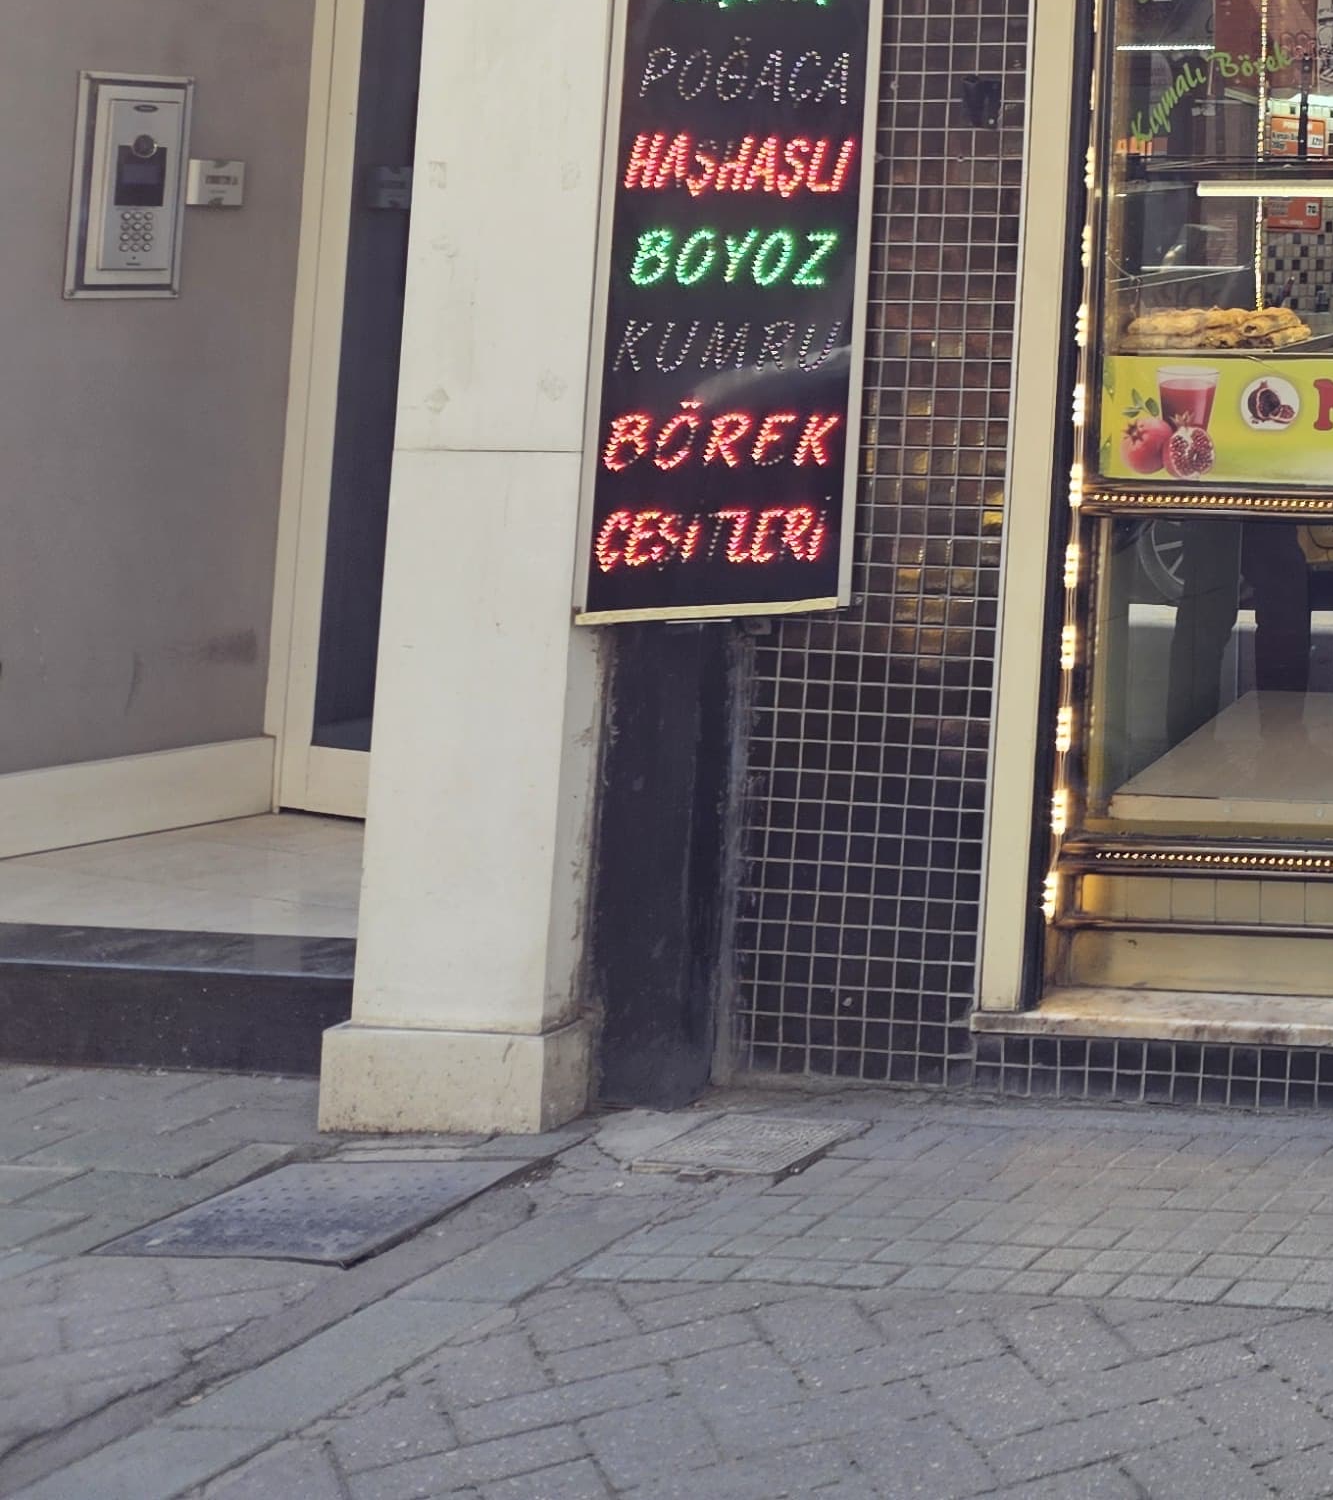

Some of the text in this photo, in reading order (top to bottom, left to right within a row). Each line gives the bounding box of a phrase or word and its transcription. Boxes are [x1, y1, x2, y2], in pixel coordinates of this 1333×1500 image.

[1130, 41, 1294, 148] Kıymalı Börek
[628, 227, 841, 288] BOYOZ
[612, 319, 843, 373] KUMRU
[602, 396, 841, 472] BÖREK
